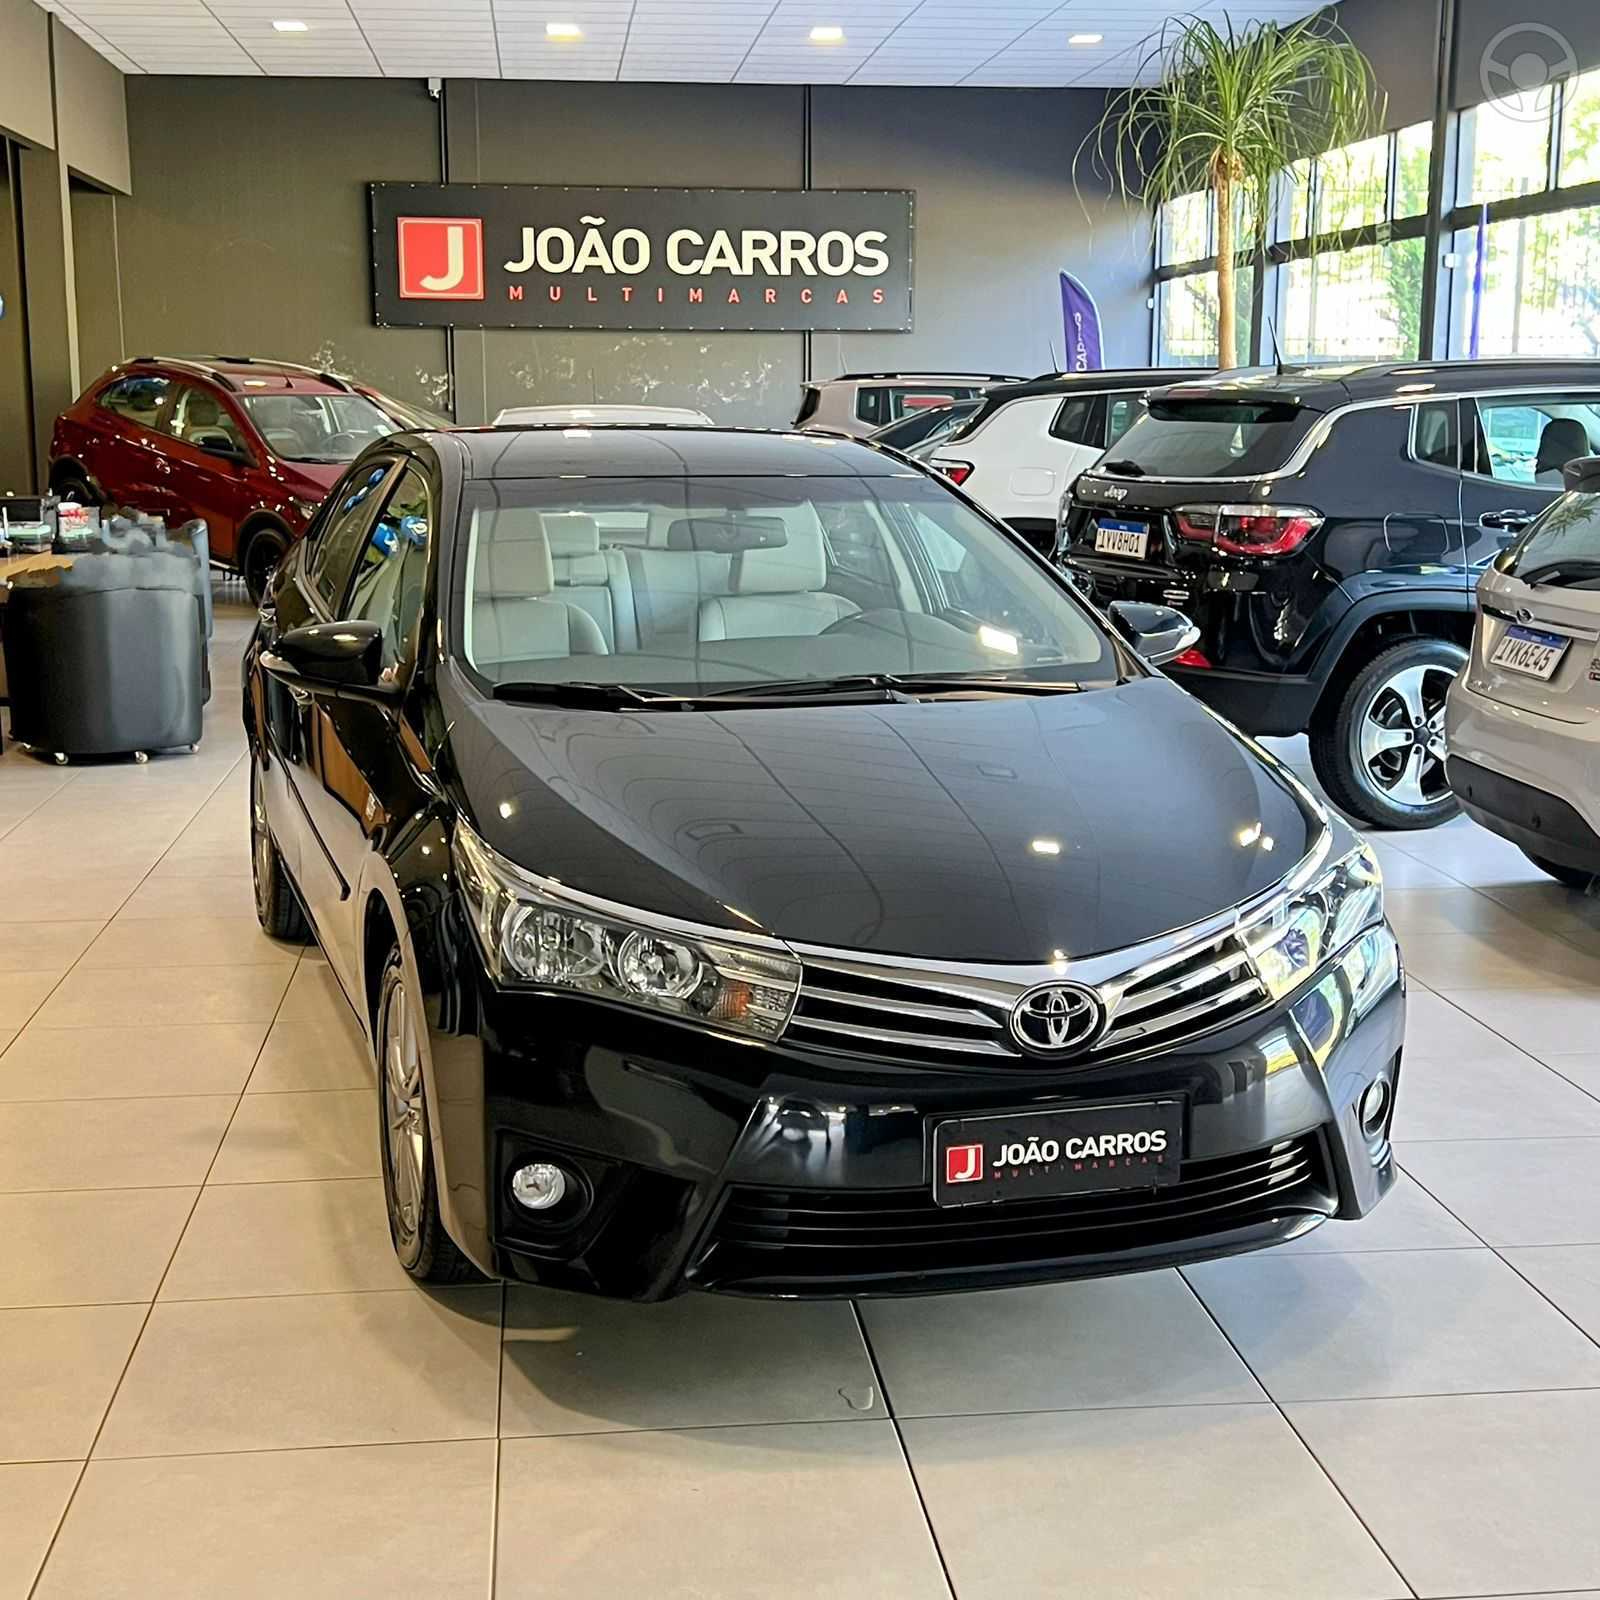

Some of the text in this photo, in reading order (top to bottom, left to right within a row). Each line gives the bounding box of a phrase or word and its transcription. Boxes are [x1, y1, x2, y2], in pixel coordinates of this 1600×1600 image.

[419, 226, 464, 291] J
[503, 215, 889, 277] JOÃO CARROS
[508, 285, 884, 304] MULTIMARCAS
[1495, 639, 1554, 671] IYK6E45
[955, 1148, 976, 1179] J
[992, 1130, 1167, 1167] JOÃO CARROS
